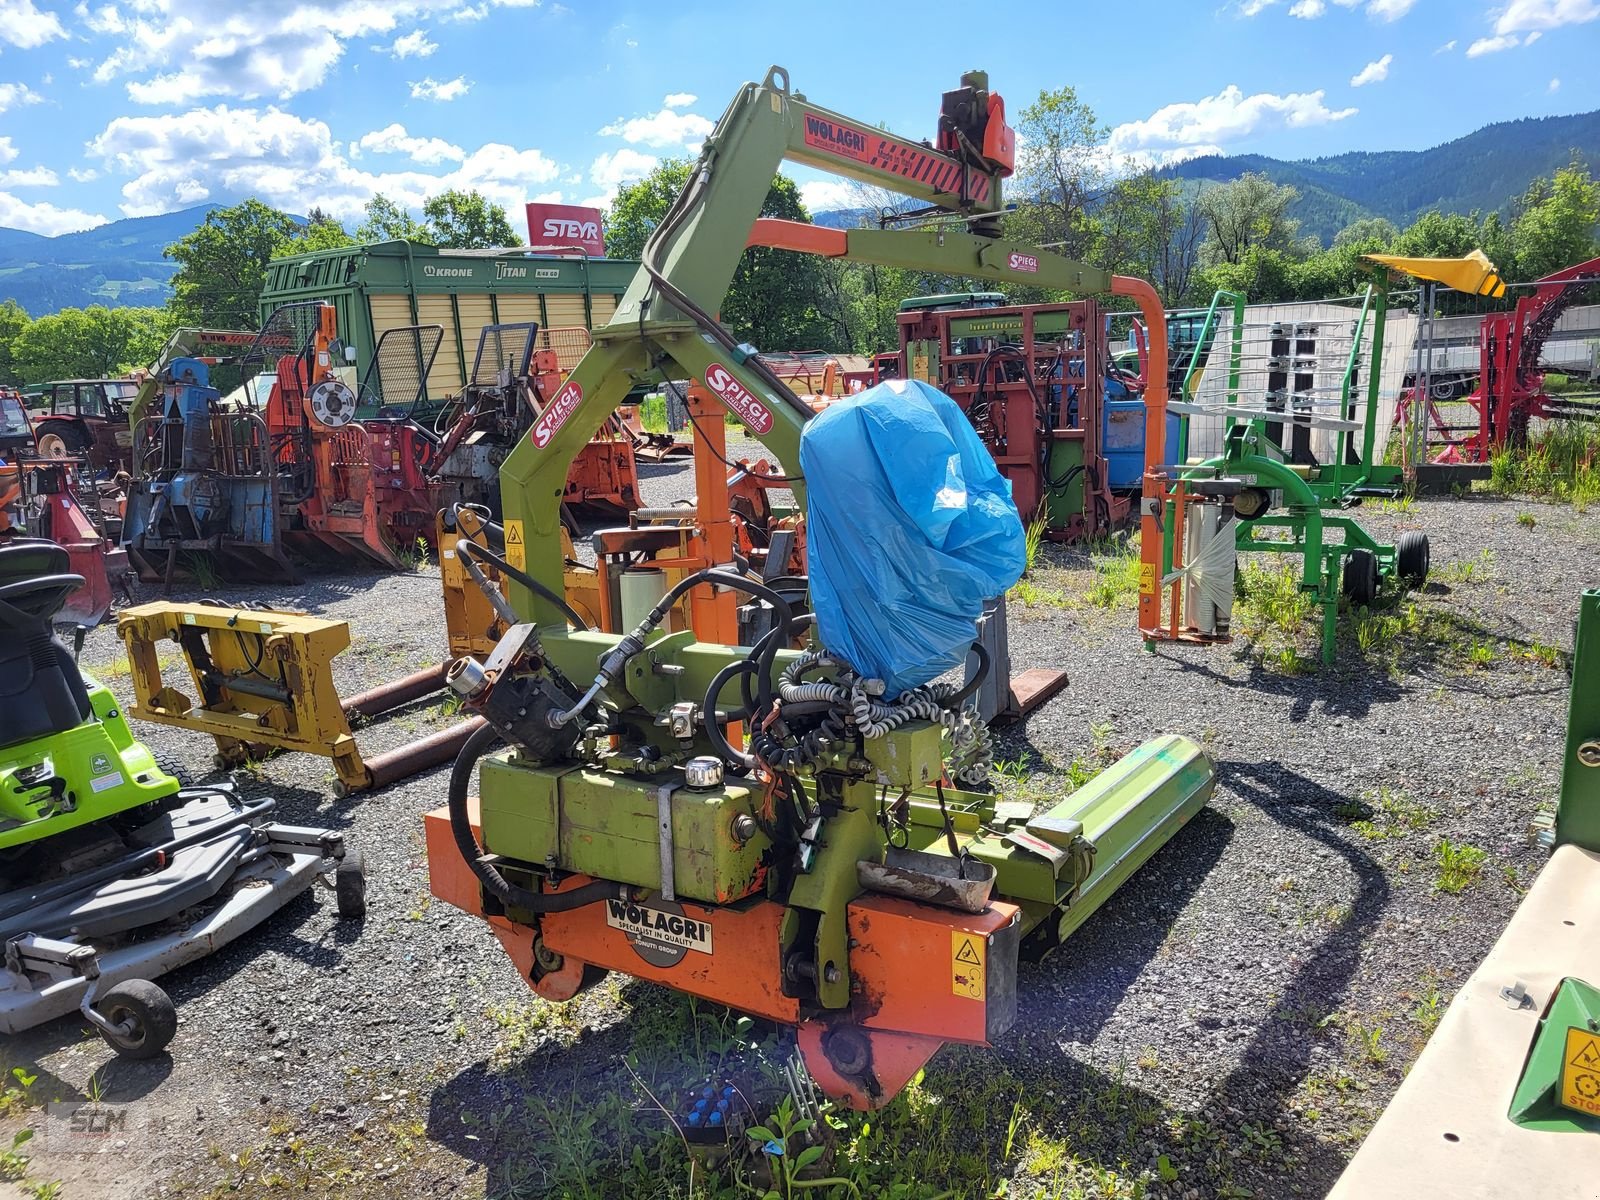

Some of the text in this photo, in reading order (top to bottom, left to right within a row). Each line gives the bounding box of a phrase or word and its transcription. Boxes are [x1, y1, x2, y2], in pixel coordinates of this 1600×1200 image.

[806, 116, 865, 153] WOLAGRI
[543, 218, 598, 240] STEYR
[436, 268, 473, 277] KRONE
[495, 261, 527, 279] TITAN
[1010, 254, 1038, 268] SPIEGL
[708, 369, 769, 426] SPIEGL
[721, 390, 764, 429] LANDTECHNIK
[535, 386, 577, 447] SPIEGL
[608, 899, 706, 943] WOLAGRI
[618, 921, 693, 947] SPECIALIST IN QUALITY
[634, 938, 678, 955] TONUTTI GROUP
